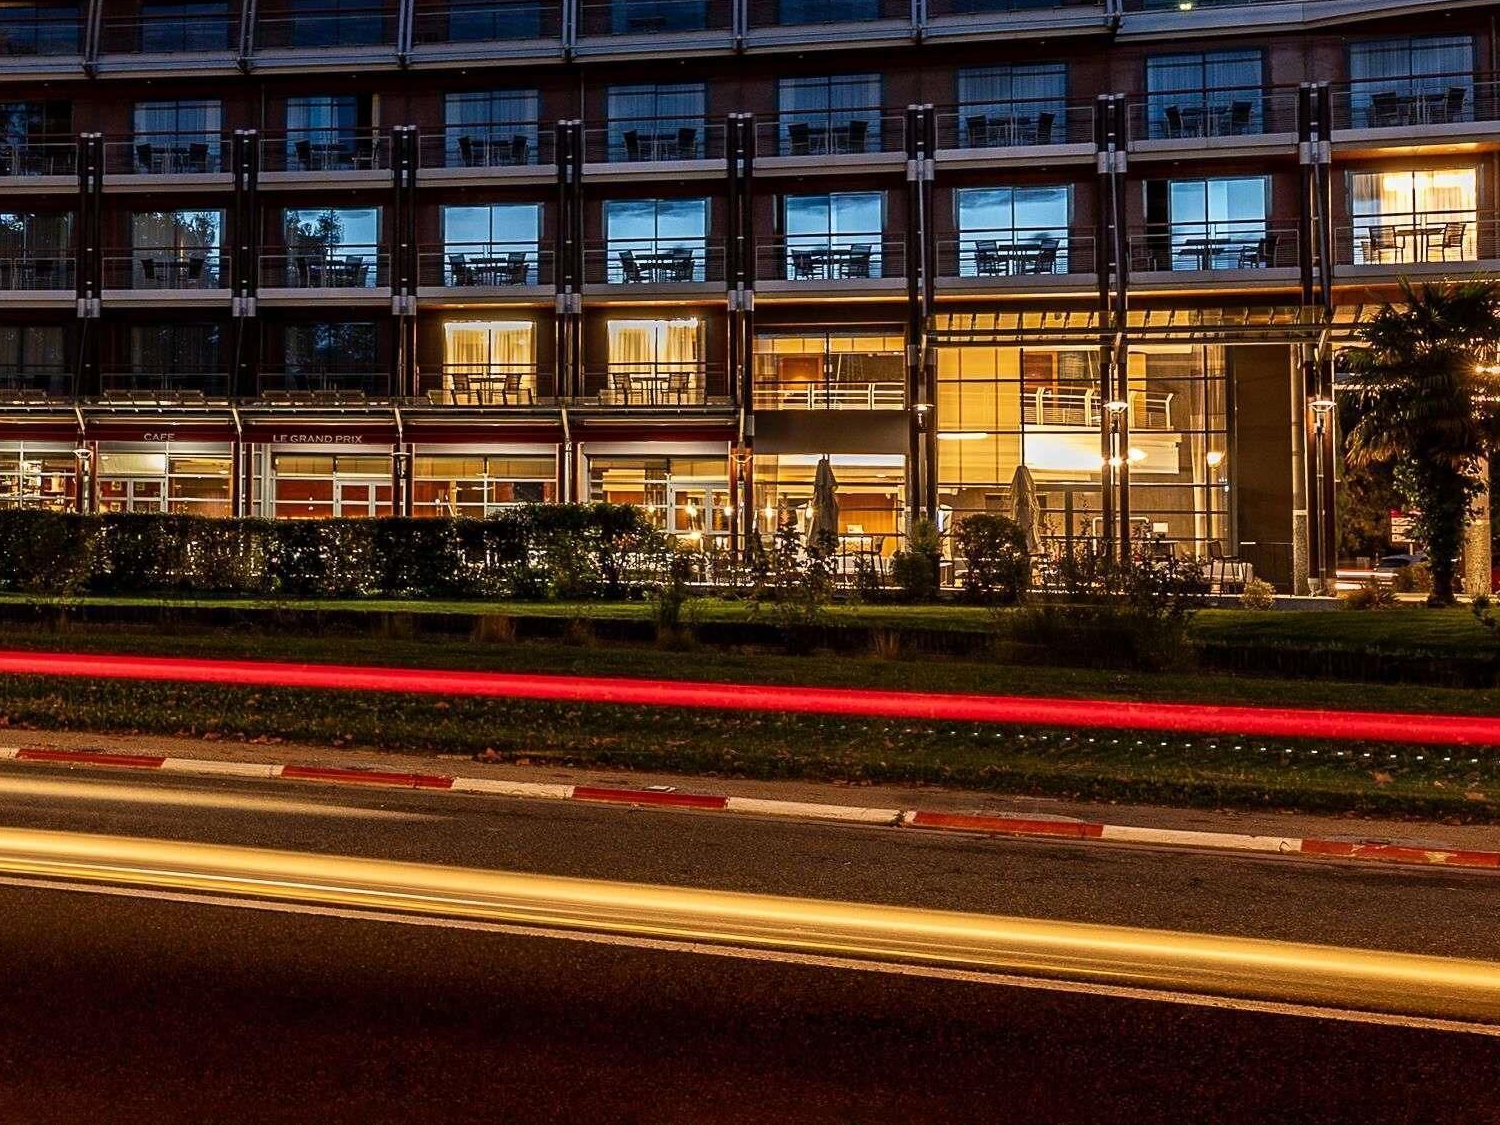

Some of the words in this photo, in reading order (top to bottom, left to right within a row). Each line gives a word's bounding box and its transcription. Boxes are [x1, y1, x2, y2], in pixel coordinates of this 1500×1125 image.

[273, 435, 288, 443] LE
[290, 435, 333, 443] GRAND
[335, 435, 363, 444] PRIX
